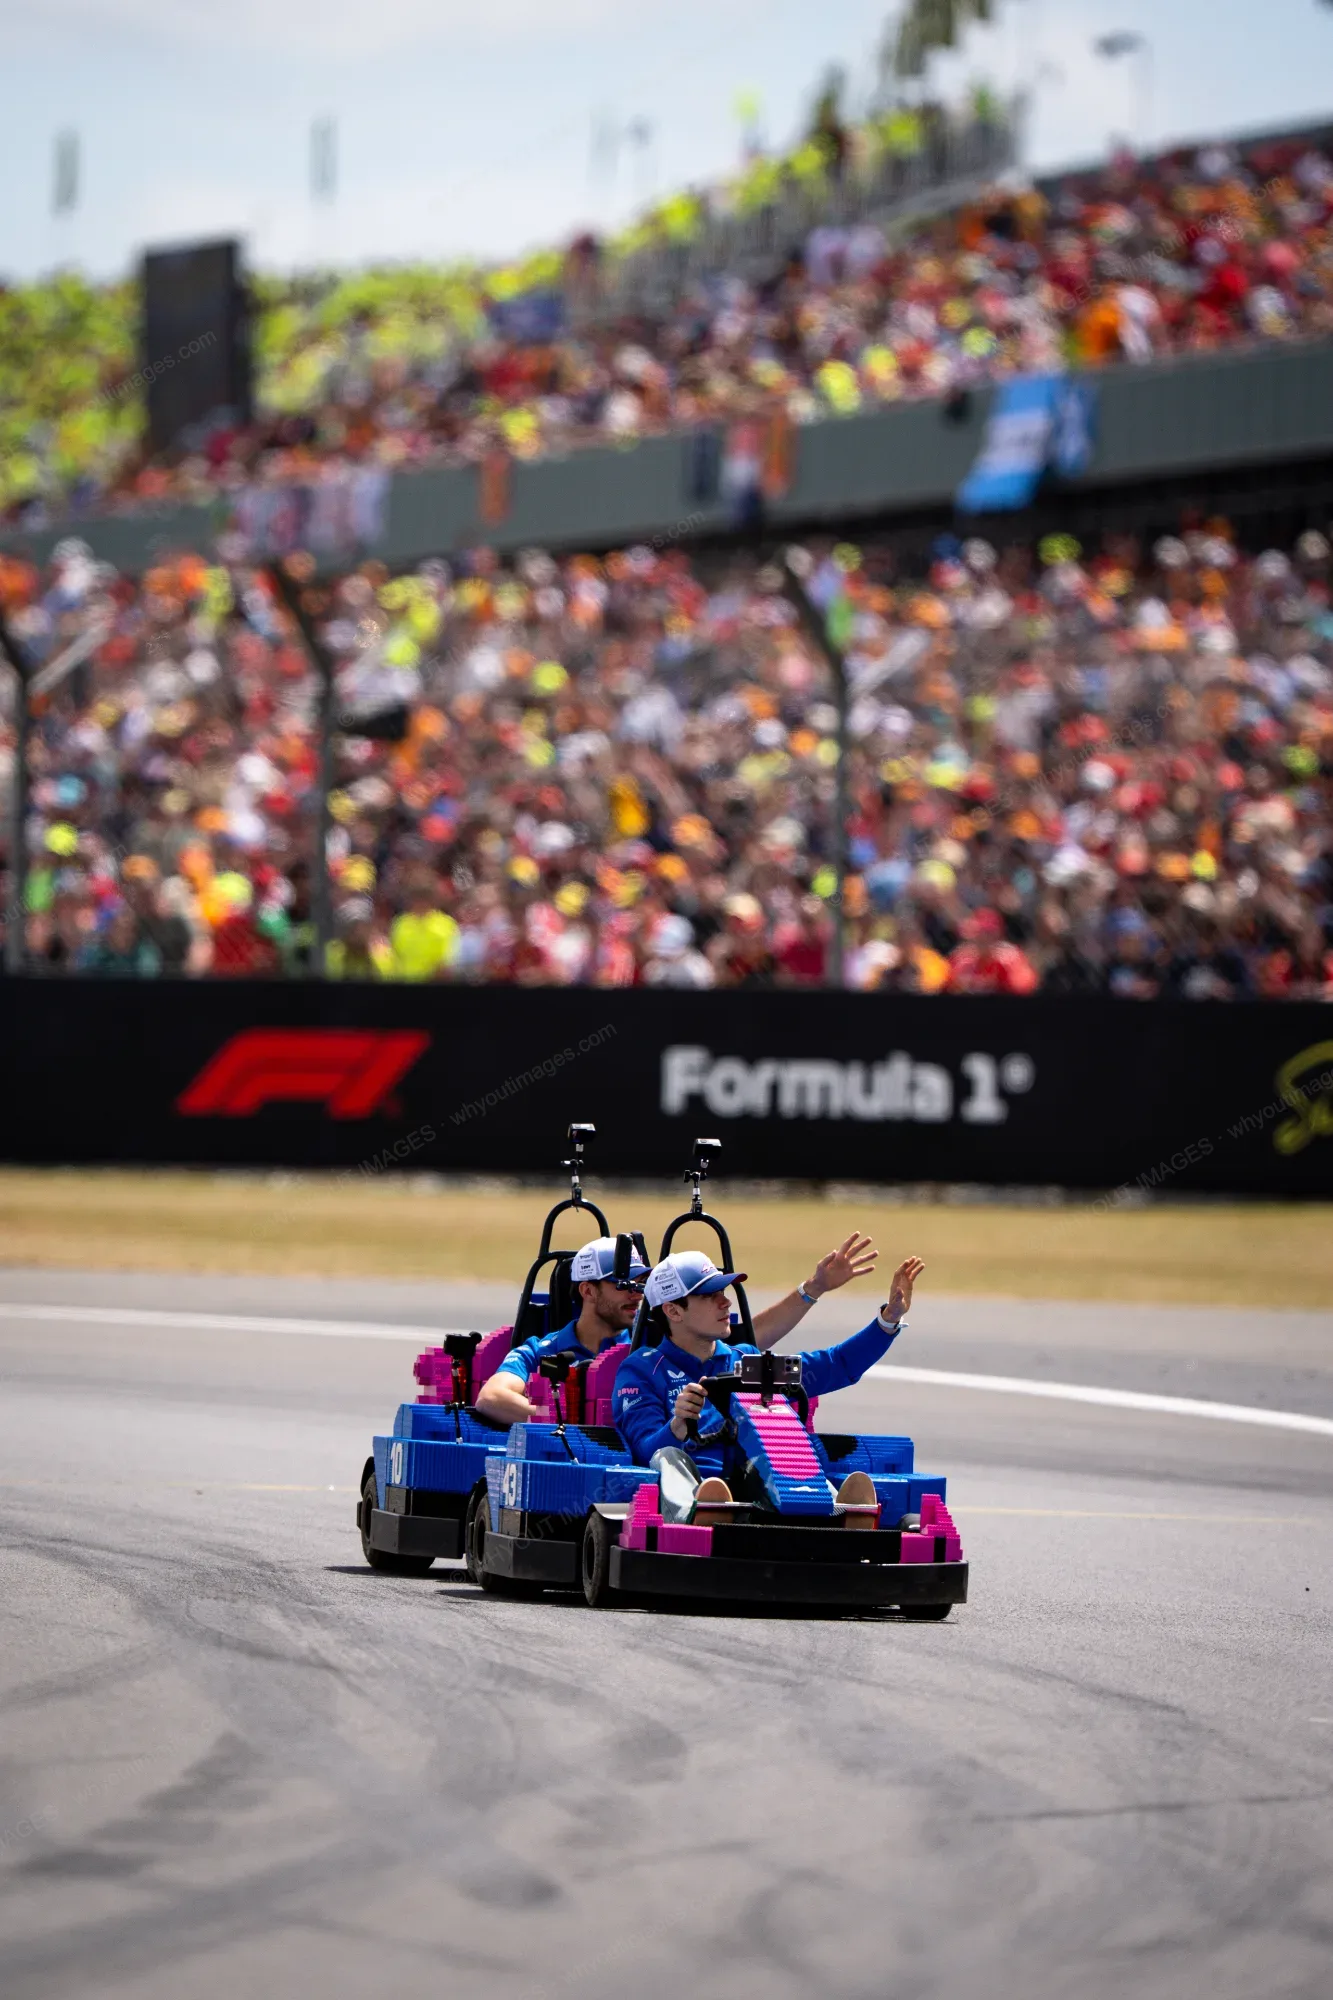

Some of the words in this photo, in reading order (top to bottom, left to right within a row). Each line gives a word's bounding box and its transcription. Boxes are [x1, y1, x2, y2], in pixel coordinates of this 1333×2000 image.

[177, 1028, 430, 1119] F1
[661, 1046, 952, 1121] Formula
[621, 1387, 639, 1395] BWT
[391, 1442, 402, 1484] 10
[503, 1462, 516, 1506] 43
